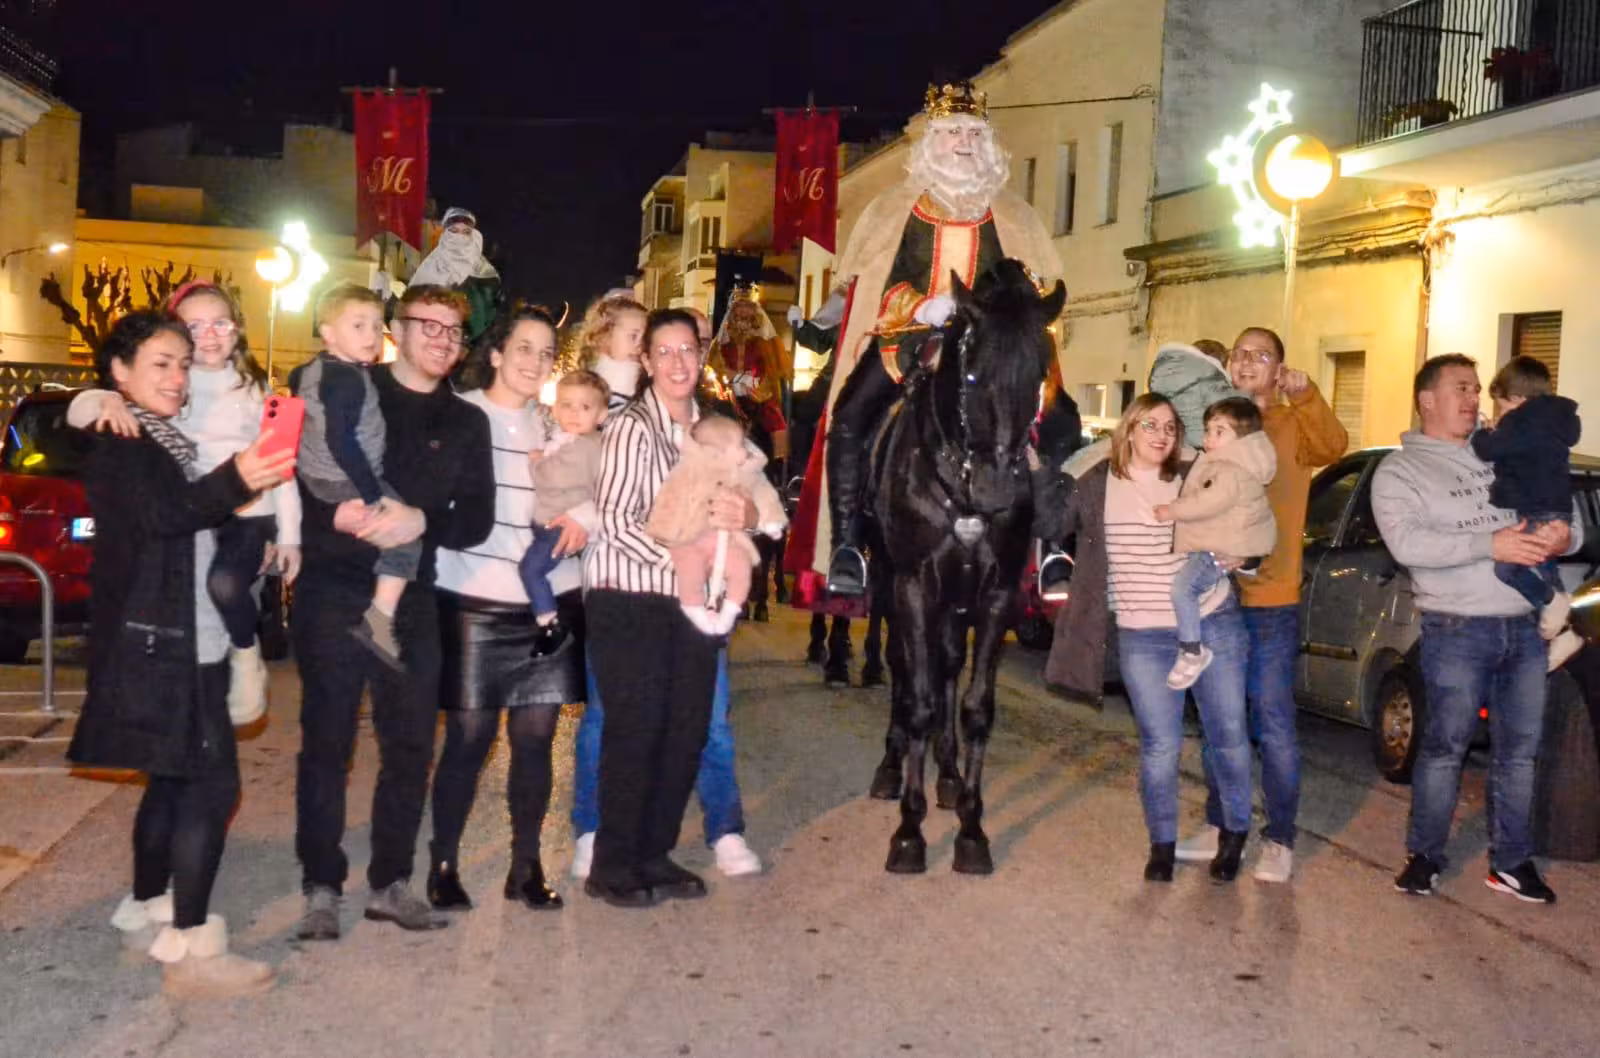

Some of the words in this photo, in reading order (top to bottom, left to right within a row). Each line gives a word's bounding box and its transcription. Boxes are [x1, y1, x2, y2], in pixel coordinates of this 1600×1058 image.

[366, 156, 415, 195] M
[783, 167, 825, 201] M
[1449, 488, 1472, 498] NEW
